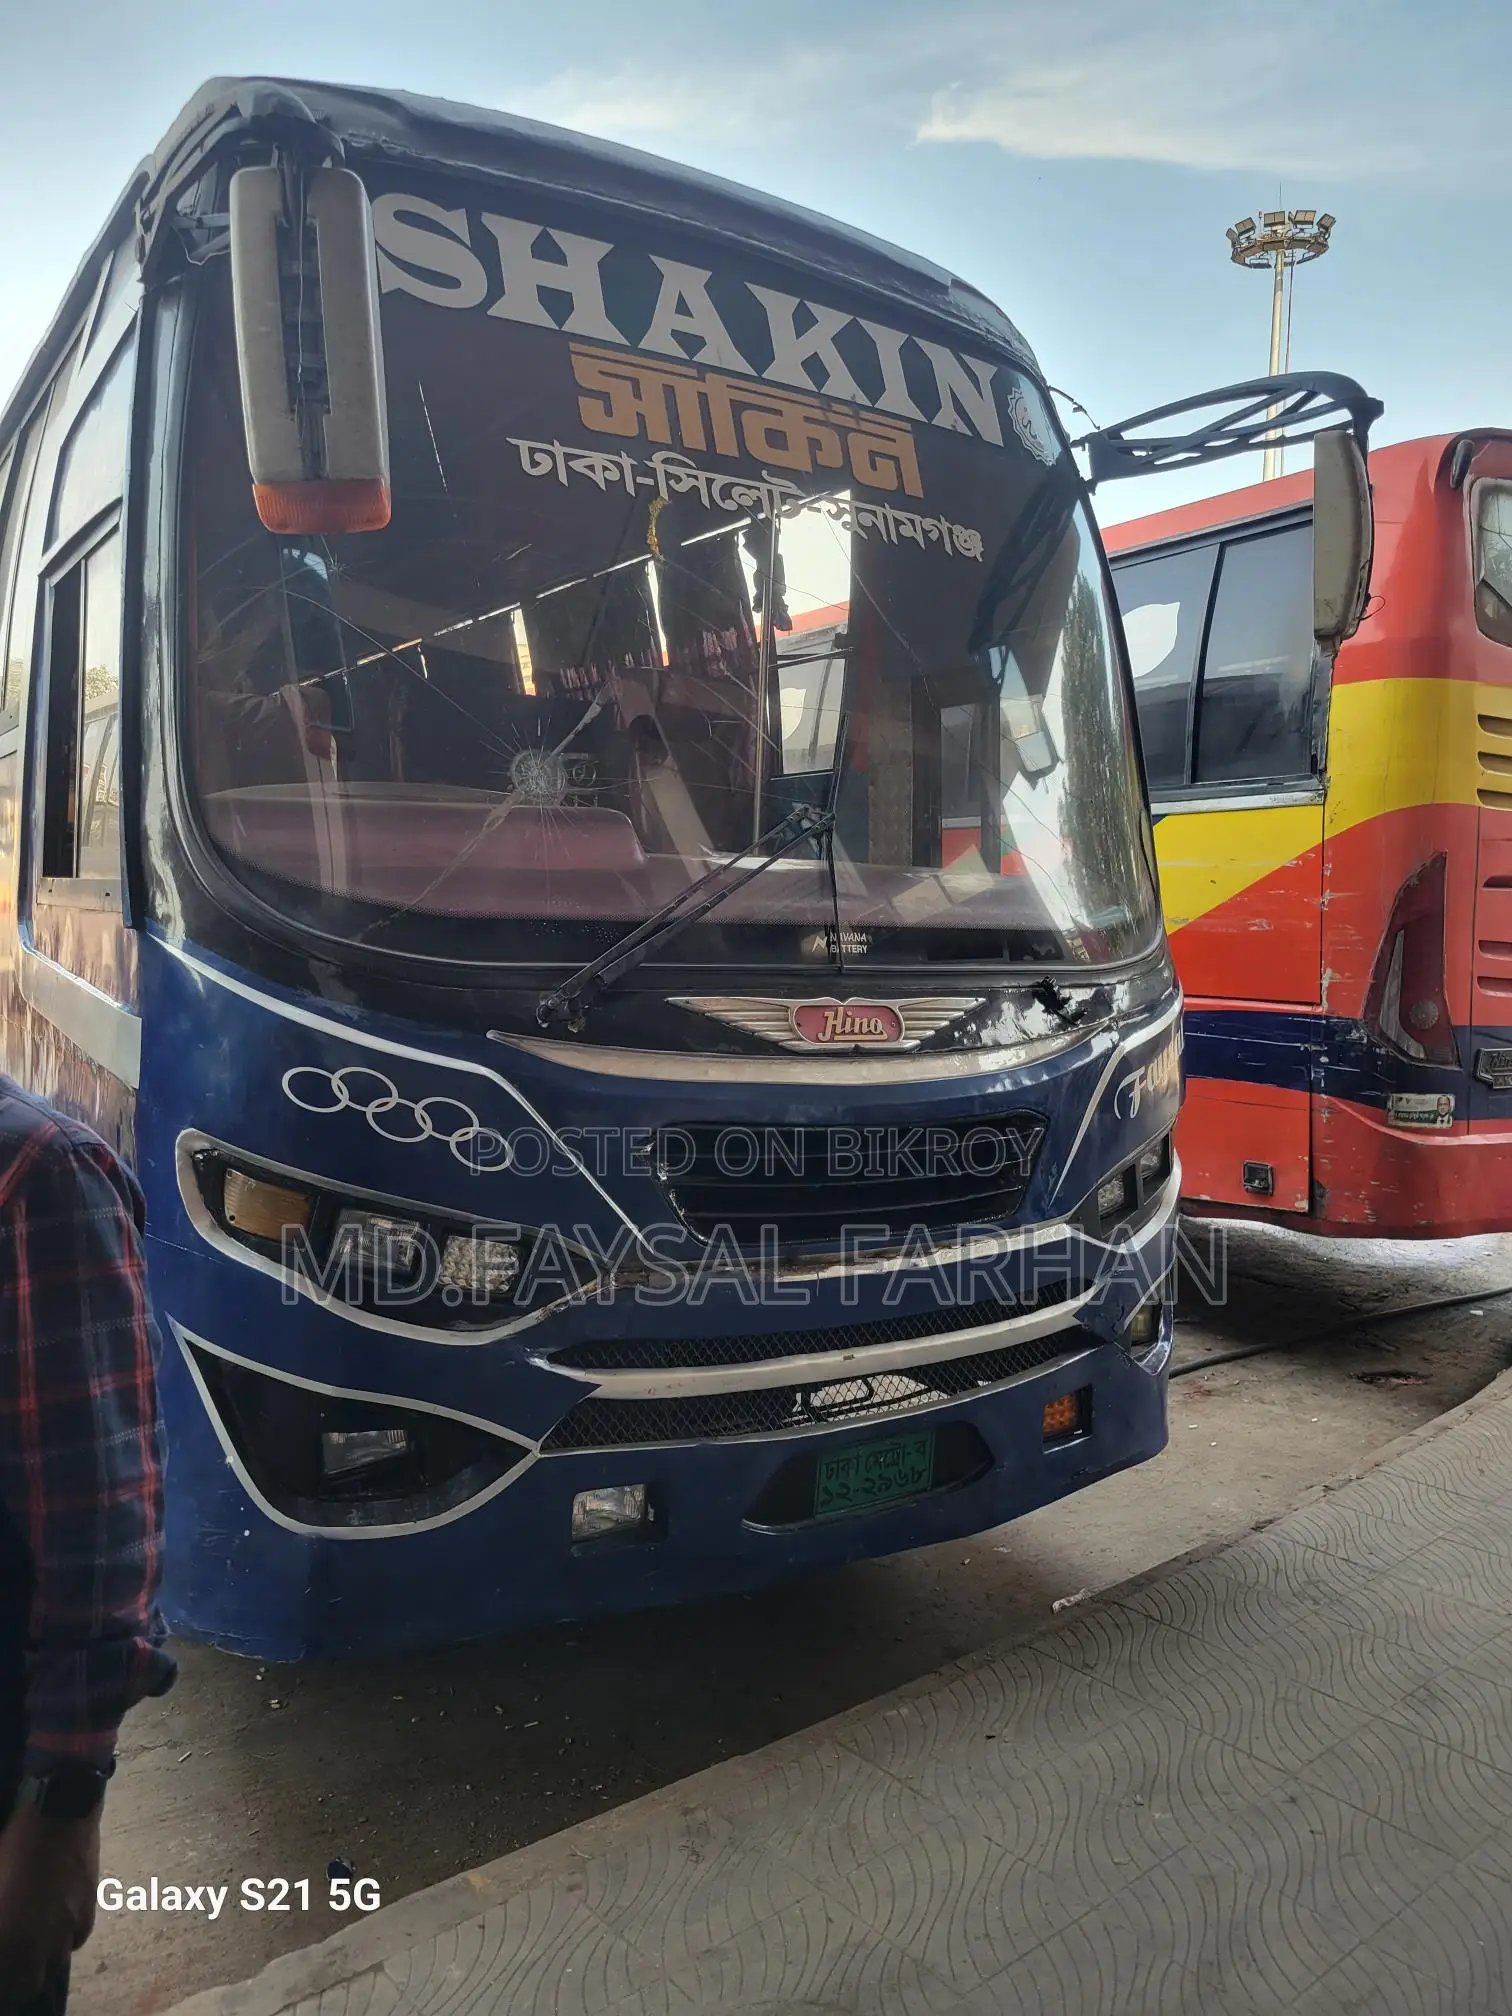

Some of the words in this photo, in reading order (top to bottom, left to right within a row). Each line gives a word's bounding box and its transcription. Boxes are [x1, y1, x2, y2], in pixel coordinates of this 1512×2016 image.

[371, 192, 1005, 448] SHAKIN
[831, 944, 867, 953] BTTERY
[818, 1007, 888, 1041] Hino
